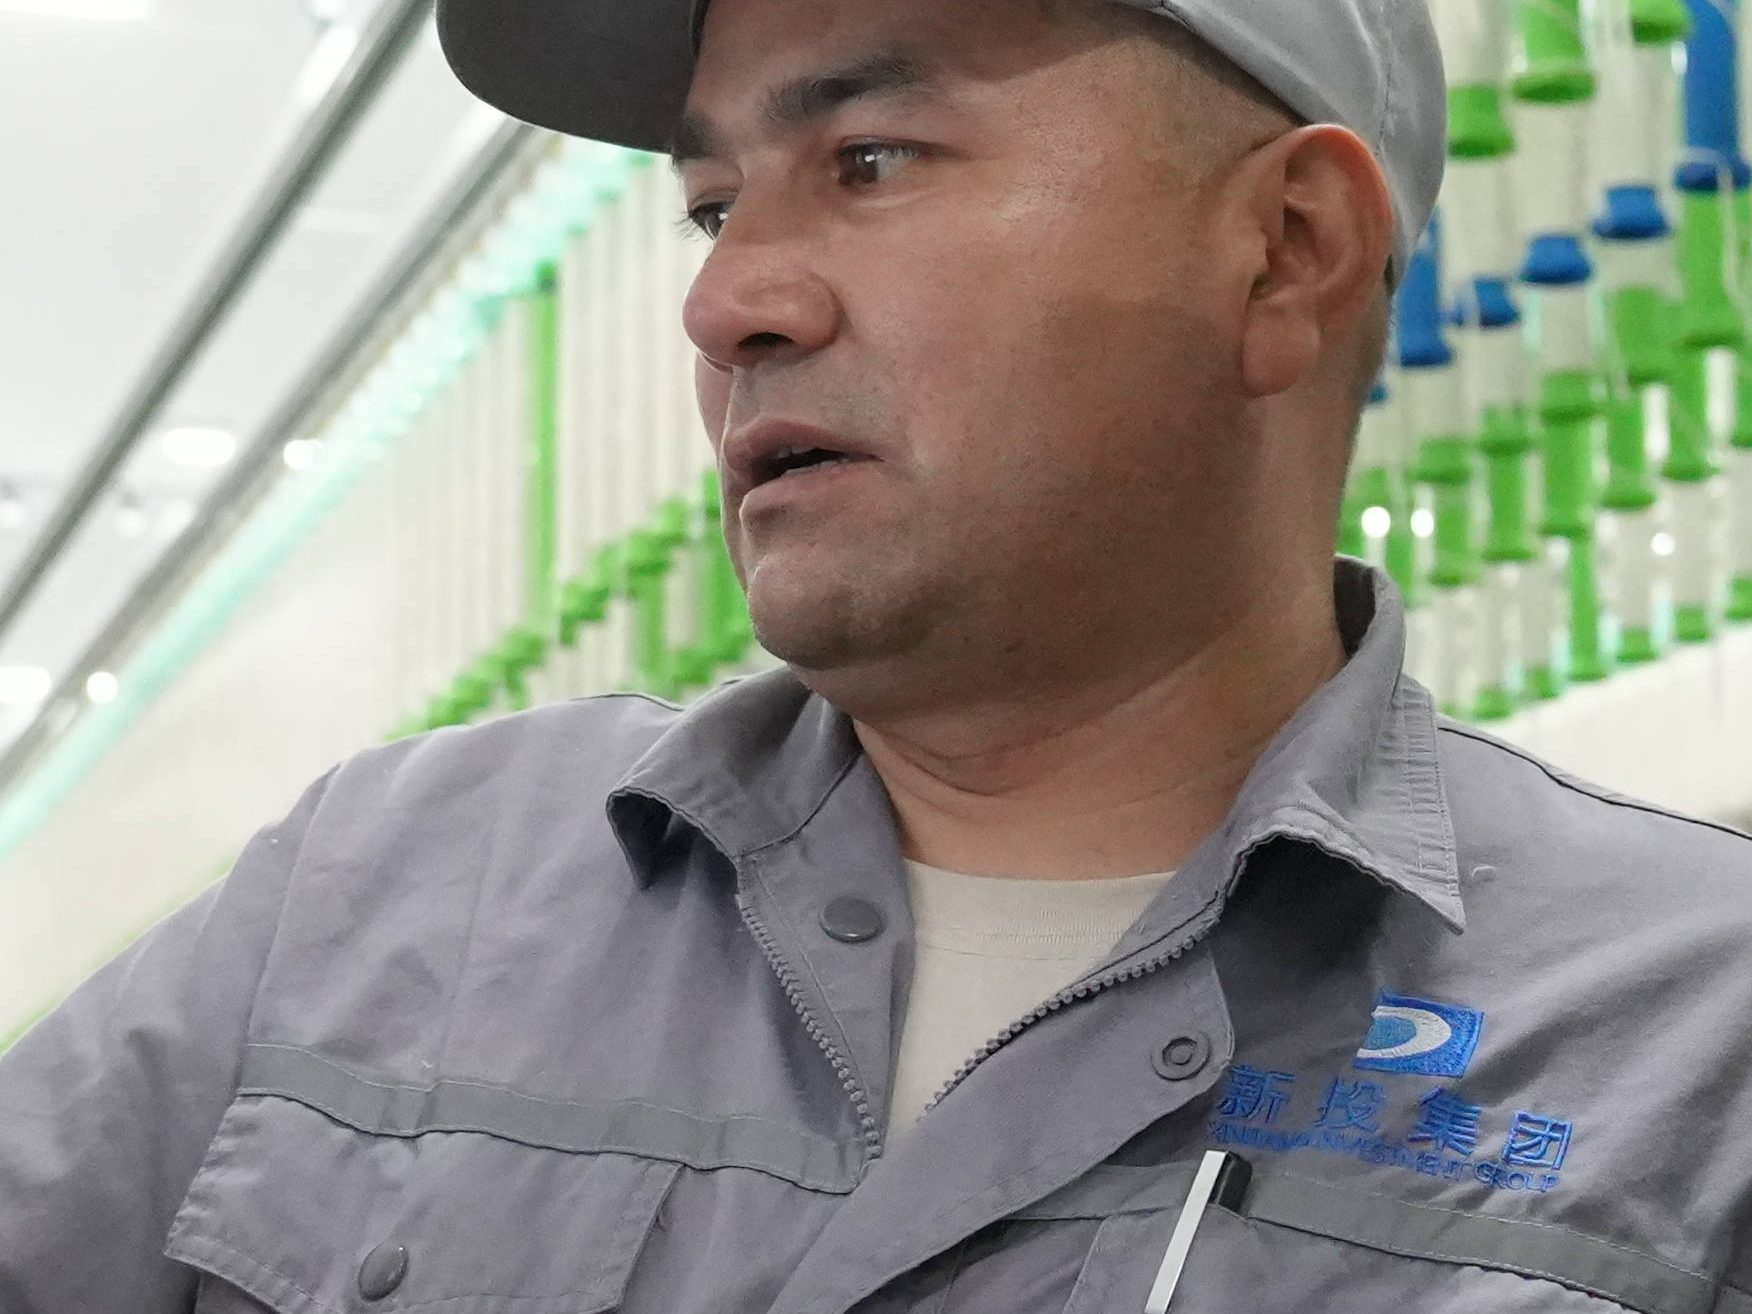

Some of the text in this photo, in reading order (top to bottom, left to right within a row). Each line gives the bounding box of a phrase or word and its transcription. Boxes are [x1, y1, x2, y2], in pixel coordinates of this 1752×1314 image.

[1215, 1063, 1574, 1172] 新投集团
[1473, 1160, 1561, 1193] GROUP
